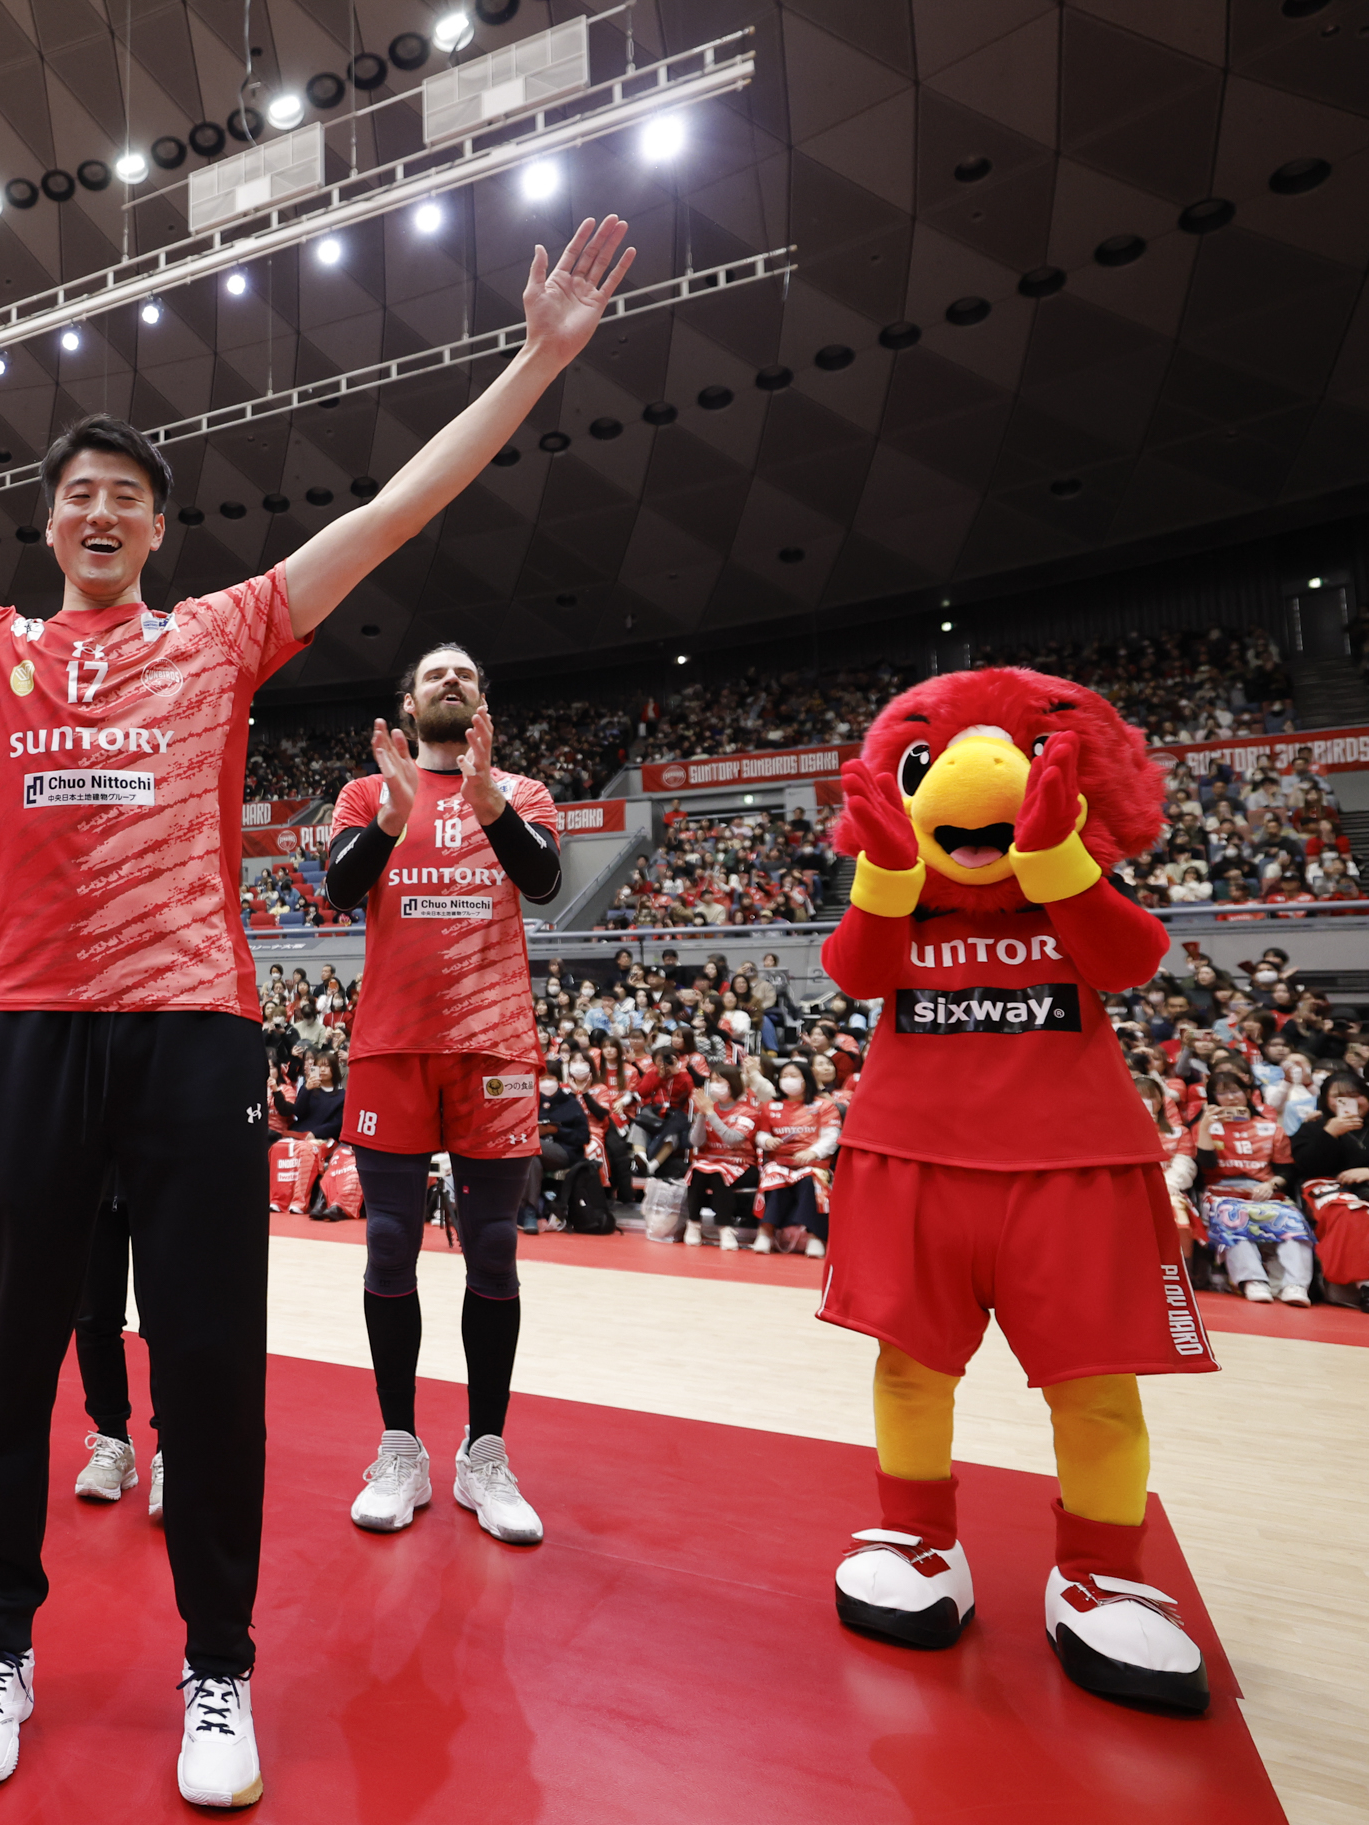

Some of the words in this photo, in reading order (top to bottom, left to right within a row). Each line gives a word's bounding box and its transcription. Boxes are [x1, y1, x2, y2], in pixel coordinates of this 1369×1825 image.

[65, 661, 109, 703] 17
[9, 726, 175, 758] SUNTORY
[689, 761, 740, 784] SUNTORY
[741, 755, 798, 778] SUNBIRDS
[799, 751, 839, 774] OSAKA
[47, 793, 137, 802] 中央日本土地建物グループ
[48, 776, 86, 790] Chuo
[91, 775, 151, 791] Nittochi
[434, 818, 462, 848] 18
[566, 808, 604, 831] OSAKA
[388, 867, 507, 886] SUNTORY
[421, 900, 447, 908] Chuo
[450, 900, 491, 910] Nittochi
[910, 935, 1064, 968] UNTOR
[913, 997, 1053, 1025] sixway
[357, 1110, 377, 1137] 18
[1160, 1264, 1187, 1307] PLAY
[1168, 1310, 1204, 1356] HARD
